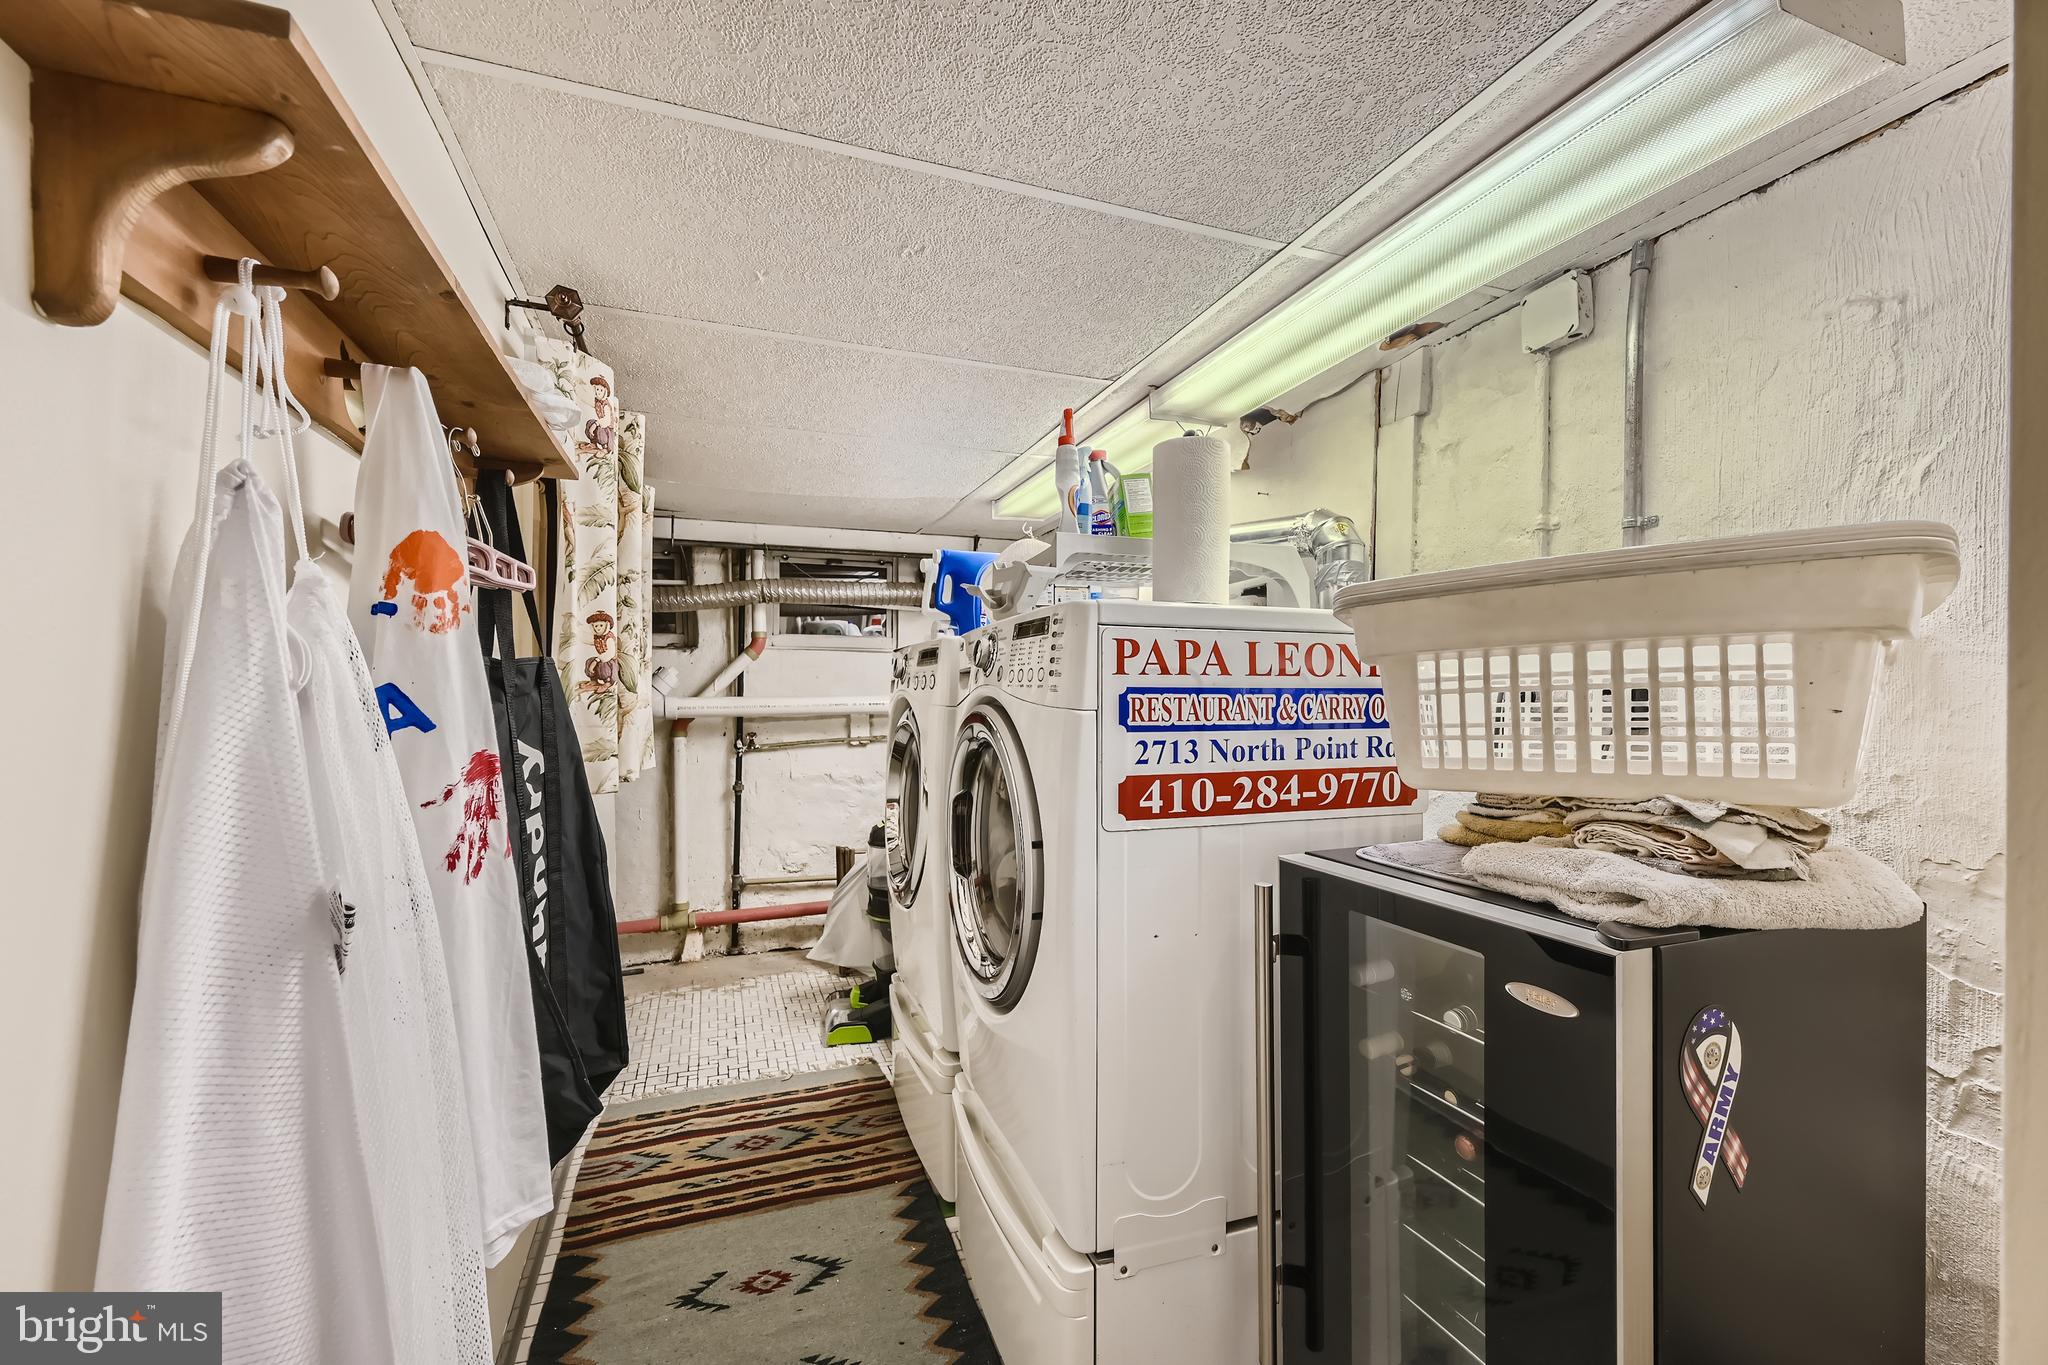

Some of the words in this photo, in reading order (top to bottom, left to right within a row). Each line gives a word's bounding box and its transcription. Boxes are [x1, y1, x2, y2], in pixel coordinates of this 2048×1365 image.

[1112, 637, 1232, 677] PAPA
[1129, 695, 1274, 722] RESTAURANT
[1279, 696, 1297, 722] &
[1300, 696, 1367, 721] CARRY
[1134, 738, 1199, 765] 2713
[1208, 737, 1285, 763] North
[1294, 735, 1359, 761] Point
[1139, 769, 1401, 815] 410-284-9770
[1702, 1061, 1740, 1167] ARMY
